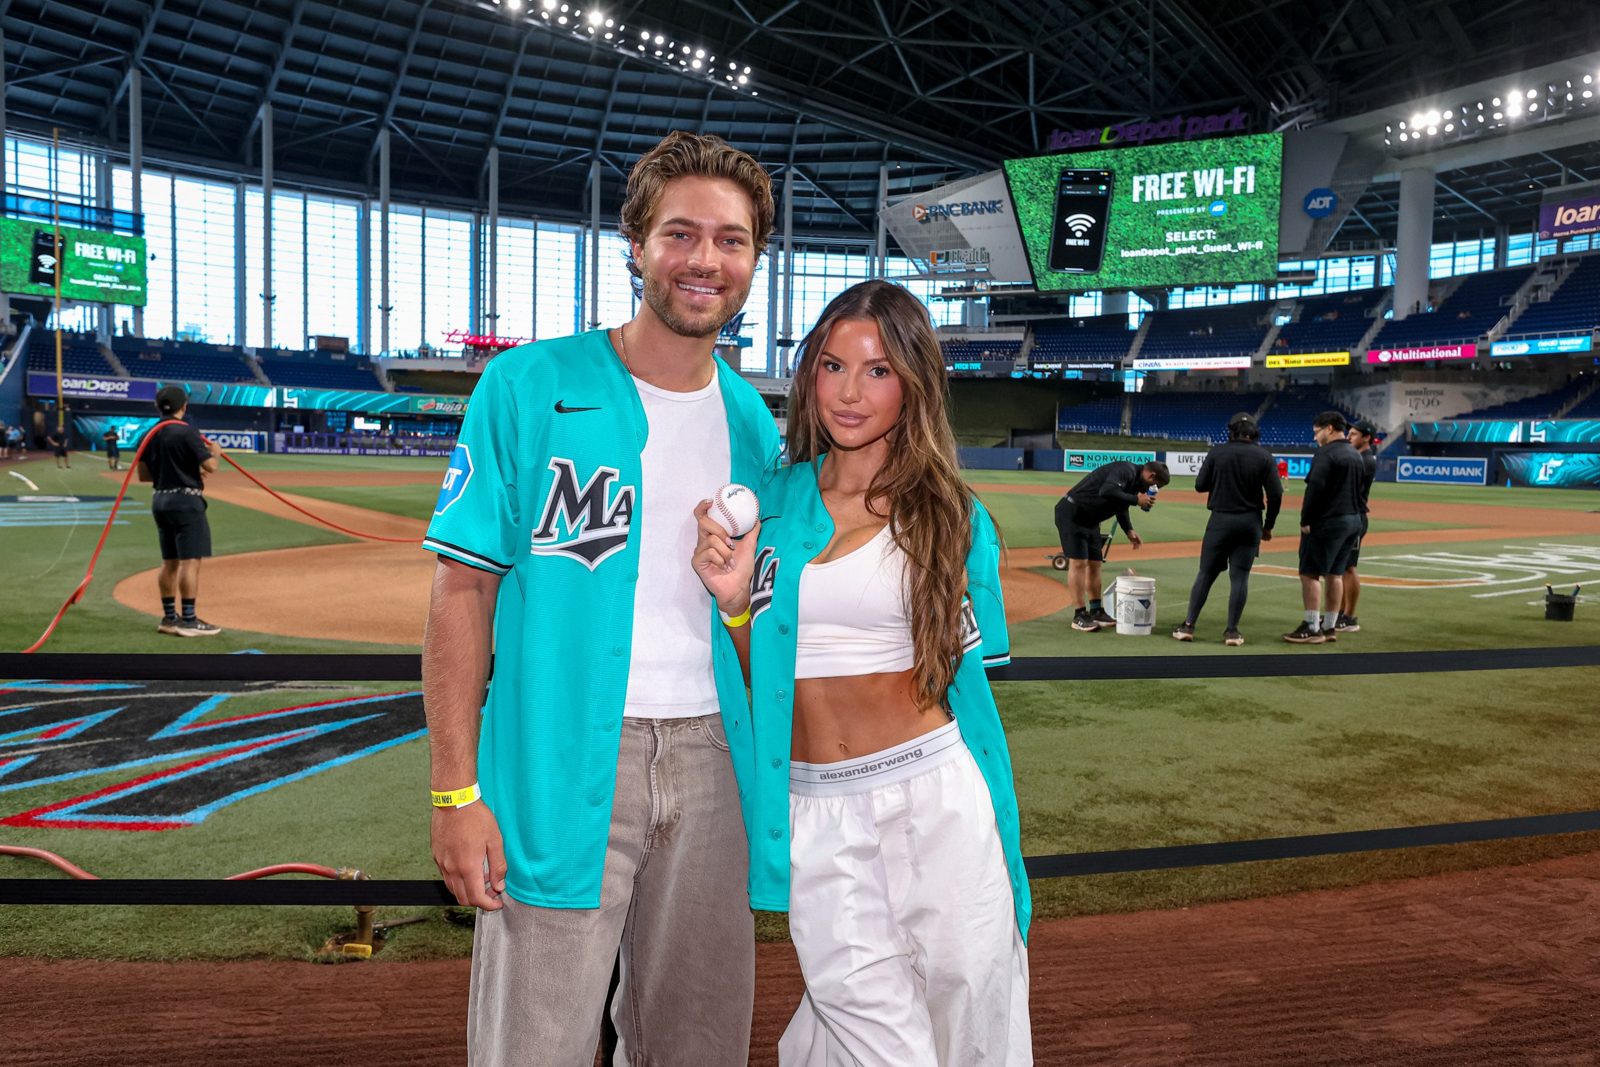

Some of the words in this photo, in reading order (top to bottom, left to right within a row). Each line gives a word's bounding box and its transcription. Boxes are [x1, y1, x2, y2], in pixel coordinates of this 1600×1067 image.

[1050, 115, 1182, 149] loanDepot
[1184, 107, 1247, 140] park
[1132, 172, 1187, 202] FREE
[1193, 165, 1255, 198] WI-FI
[1307, 196, 1333, 210] ADT
[1157, 207, 1195, 215] PRESENTED
[1165, 229, 1217, 242] SELECT:
[75, 242, 104, 260] FREE
[106, 246, 136, 264] WI-FI
[1392, 347, 1462, 360] Multinational
[62, 378, 130, 393] oanDepot
[1408, 397, 1440, 410] 1796
[207, 434, 251, 449] GOYA
[1069, 455, 1083, 463] NCL
[1087, 454, 1150, 463] NORWEGIAN
[1178, 455, 1196, 464] LIVE.
[1288, 459, 1310, 473] blu
[1414, 465, 1451, 476] OCEAN
[1453, 467, 1482, 477] BANK
[442, 467, 463, 490] DT
[819, 747, 923, 780] alexanderwang
